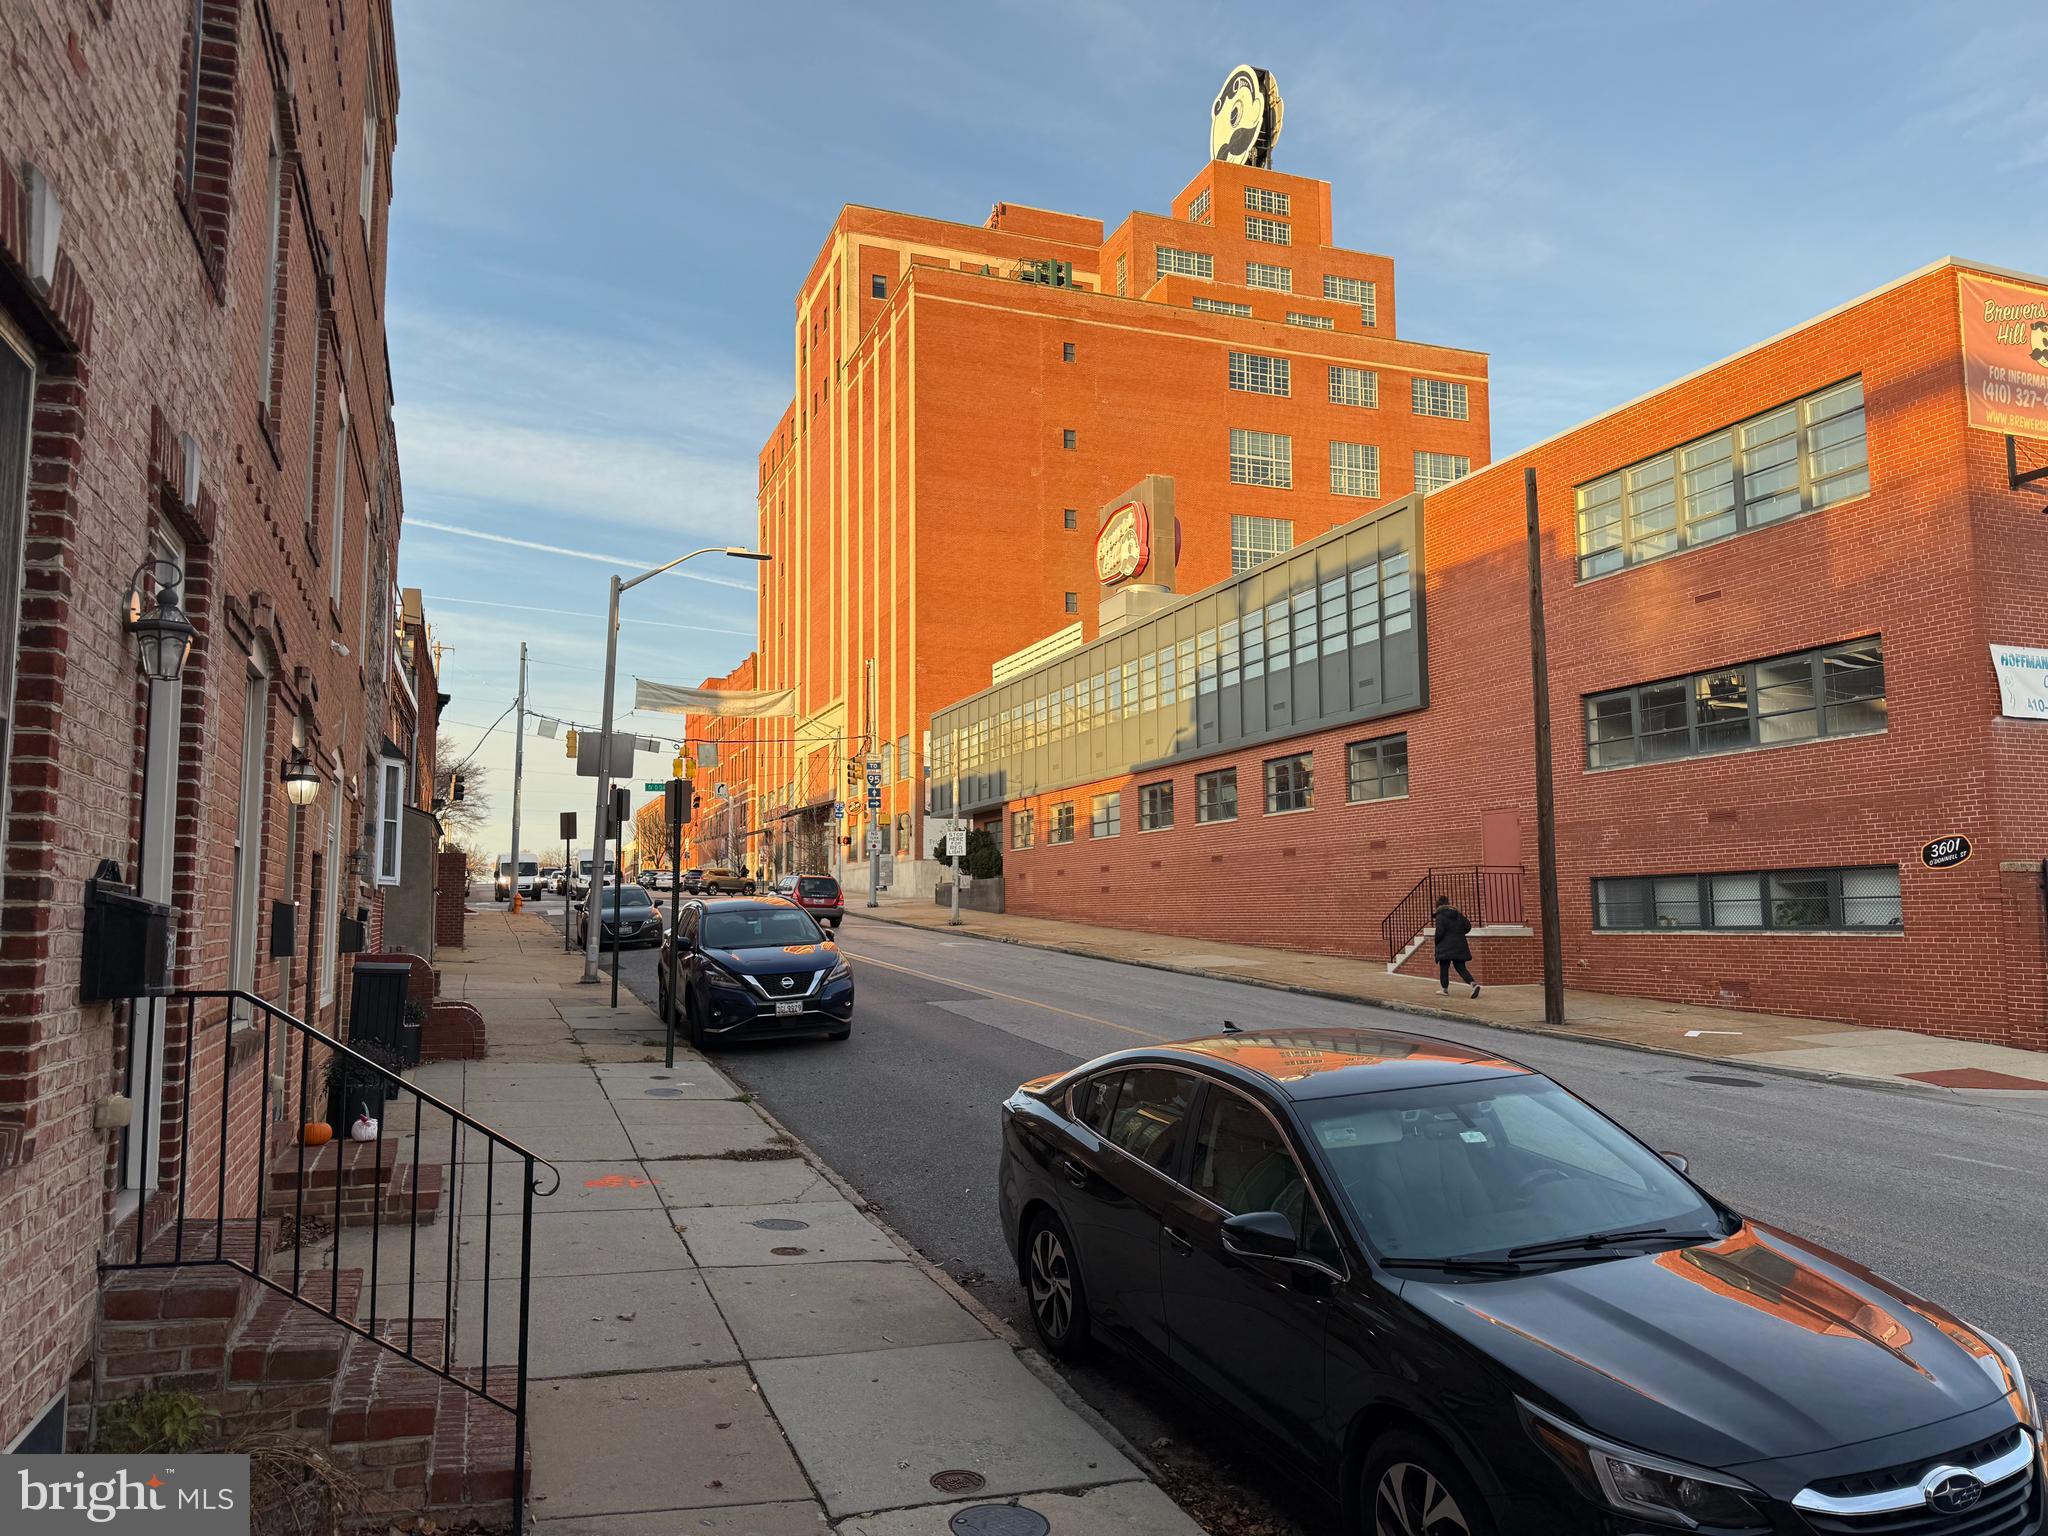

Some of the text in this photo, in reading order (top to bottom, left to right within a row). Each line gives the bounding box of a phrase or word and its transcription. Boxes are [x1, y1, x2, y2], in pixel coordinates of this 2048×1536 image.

[1984, 299, 2048, 323] Brewers
[1996, 321, 2027, 345] Hill
[1989, 365, 2006, 382] FOR
[1983, 379, 2011, 405] (410)
[2000, 653, 2048, 670] HOFFMAN
[868, 775, 880, 784] 95
[1930, 838, 1960, 857] 3601
[1929, 853, 1958, 866] O'DONNELL
